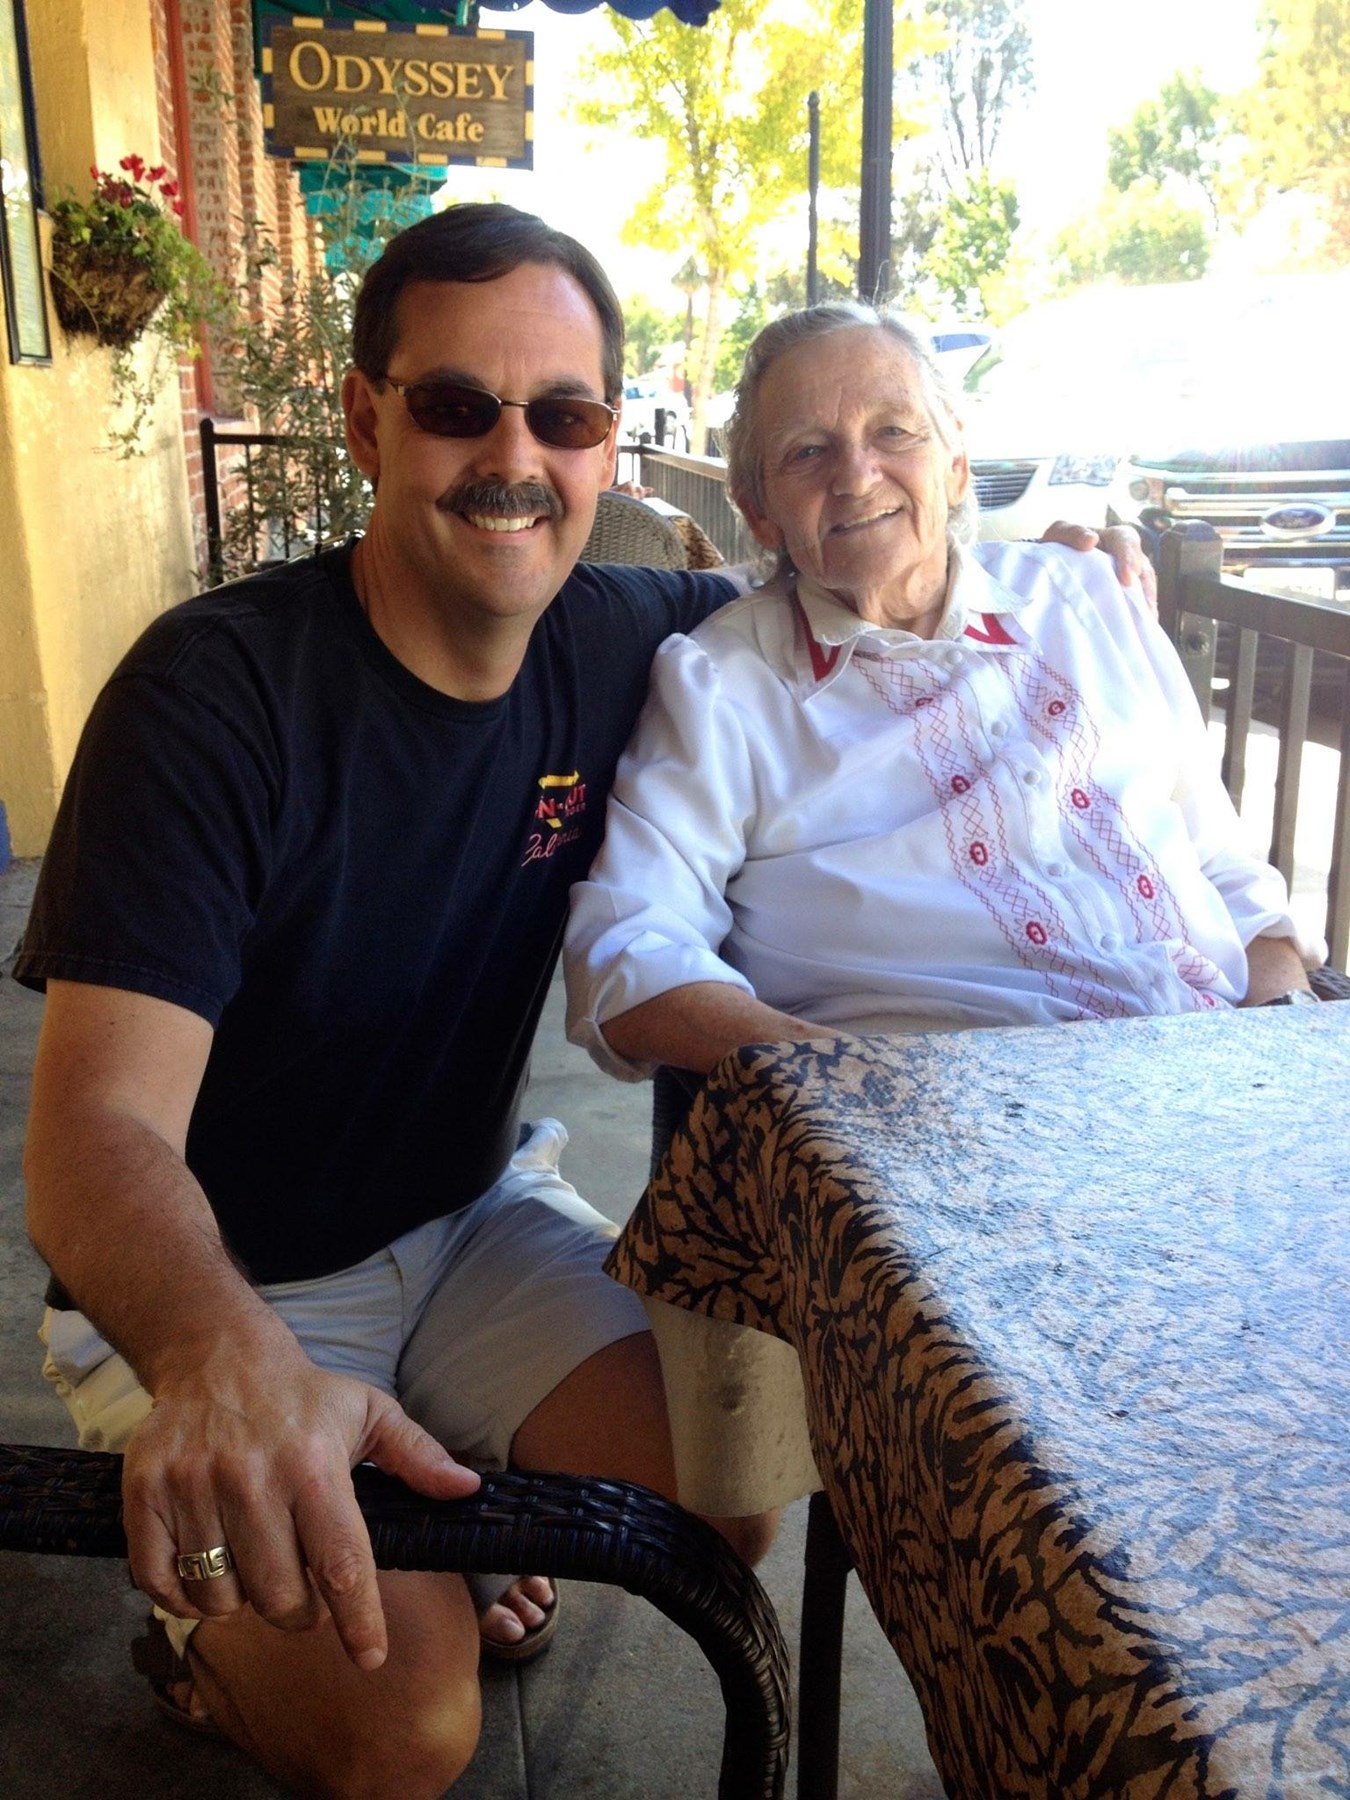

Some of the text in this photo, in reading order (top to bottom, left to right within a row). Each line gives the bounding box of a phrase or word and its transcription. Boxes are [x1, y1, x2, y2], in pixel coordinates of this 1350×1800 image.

[289, 41, 515, 100] ODYSSEY
[312, 106, 485, 143] World Cafe
